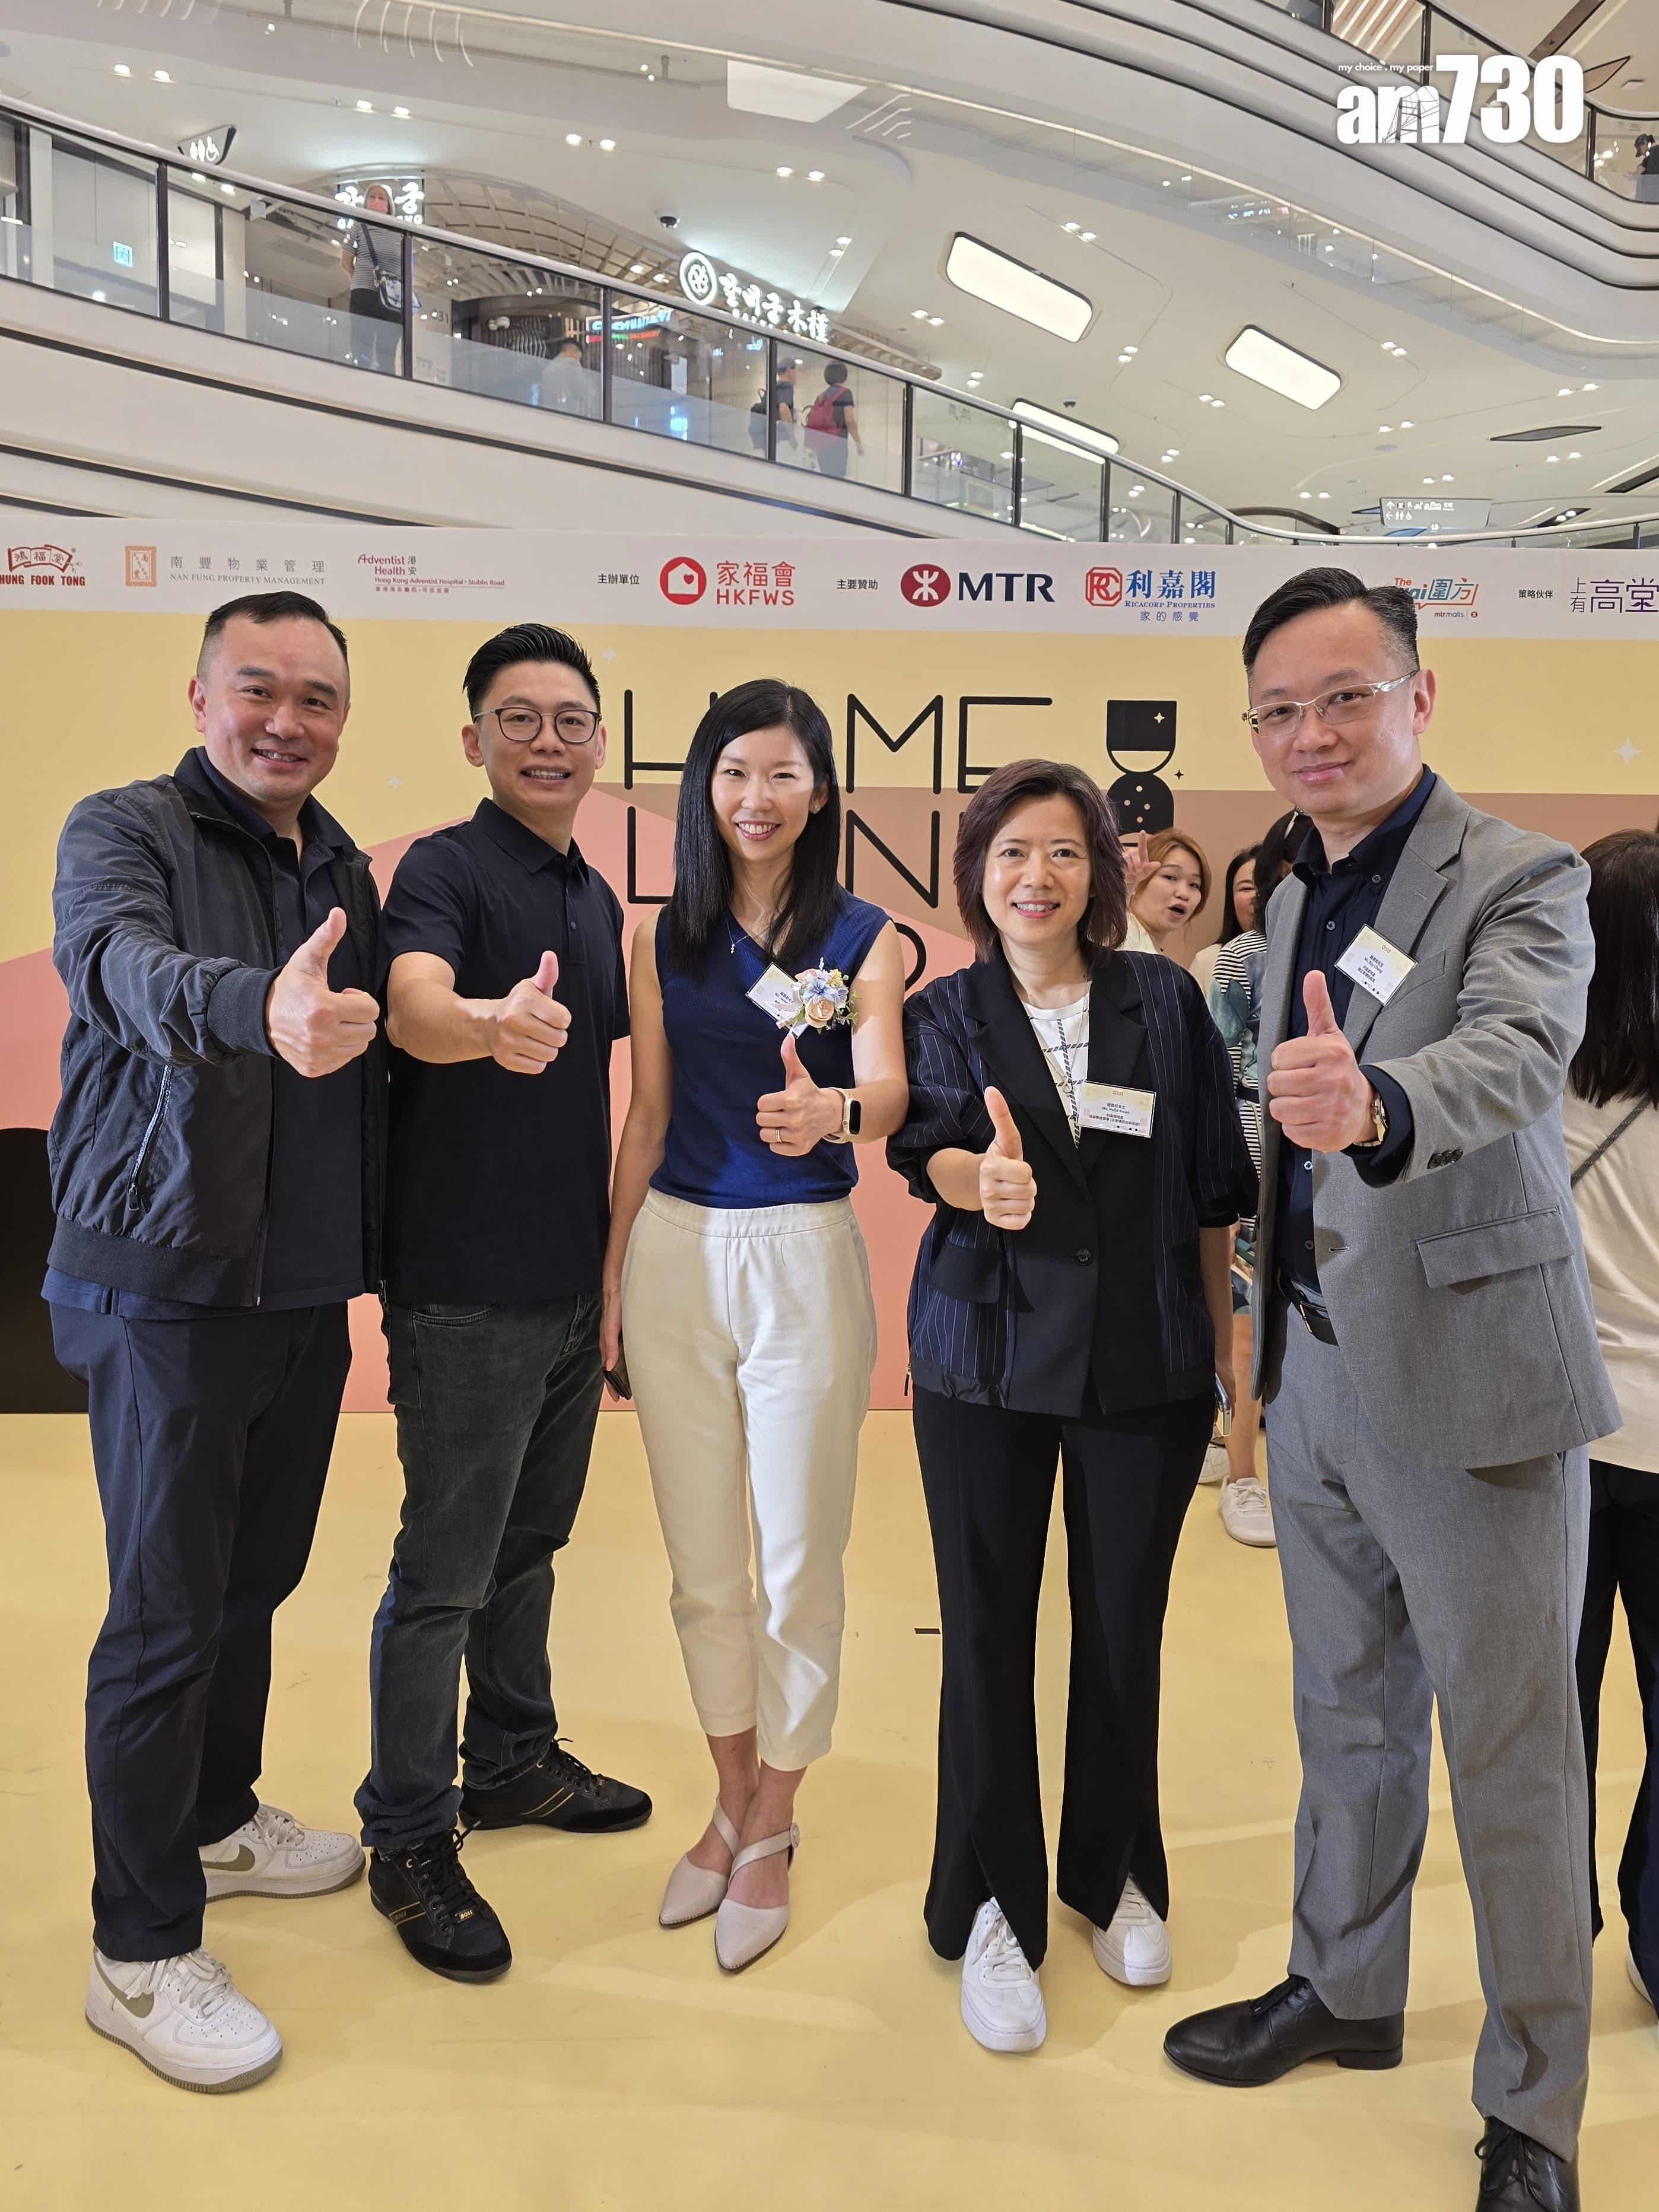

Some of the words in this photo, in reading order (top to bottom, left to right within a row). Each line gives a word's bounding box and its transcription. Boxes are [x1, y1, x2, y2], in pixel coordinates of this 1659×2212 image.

[170, 555, 325, 573] 南豐物業管理
[358, 553, 405, 564] Adventist
[374, 565, 405, 575] Health
[716, 560, 796, 587] 家福會
[30, 575, 55, 585] FOOK
[61, 576, 85, 586] TONG
[218, 574, 261, 583] PROPERTY
[263, 576, 326, 585] MANAGEMENT
[597, 573, 640, 584] 主辦單位
[1125, 569, 1216, 599] 利嘉閣
[1394, 577, 1412, 586] The
[836, 579, 878, 590] 主要贊助
[958, 572, 1055, 603] MTR
[716, 588, 795, 606] HKFWS
[1518, 589, 1553, 599] 策略伙伴
[1140, 611, 1199, 622] 家的感覺
[624, 689, 1053, 794] HME
[460, 1909, 473, 1919] BOSS
